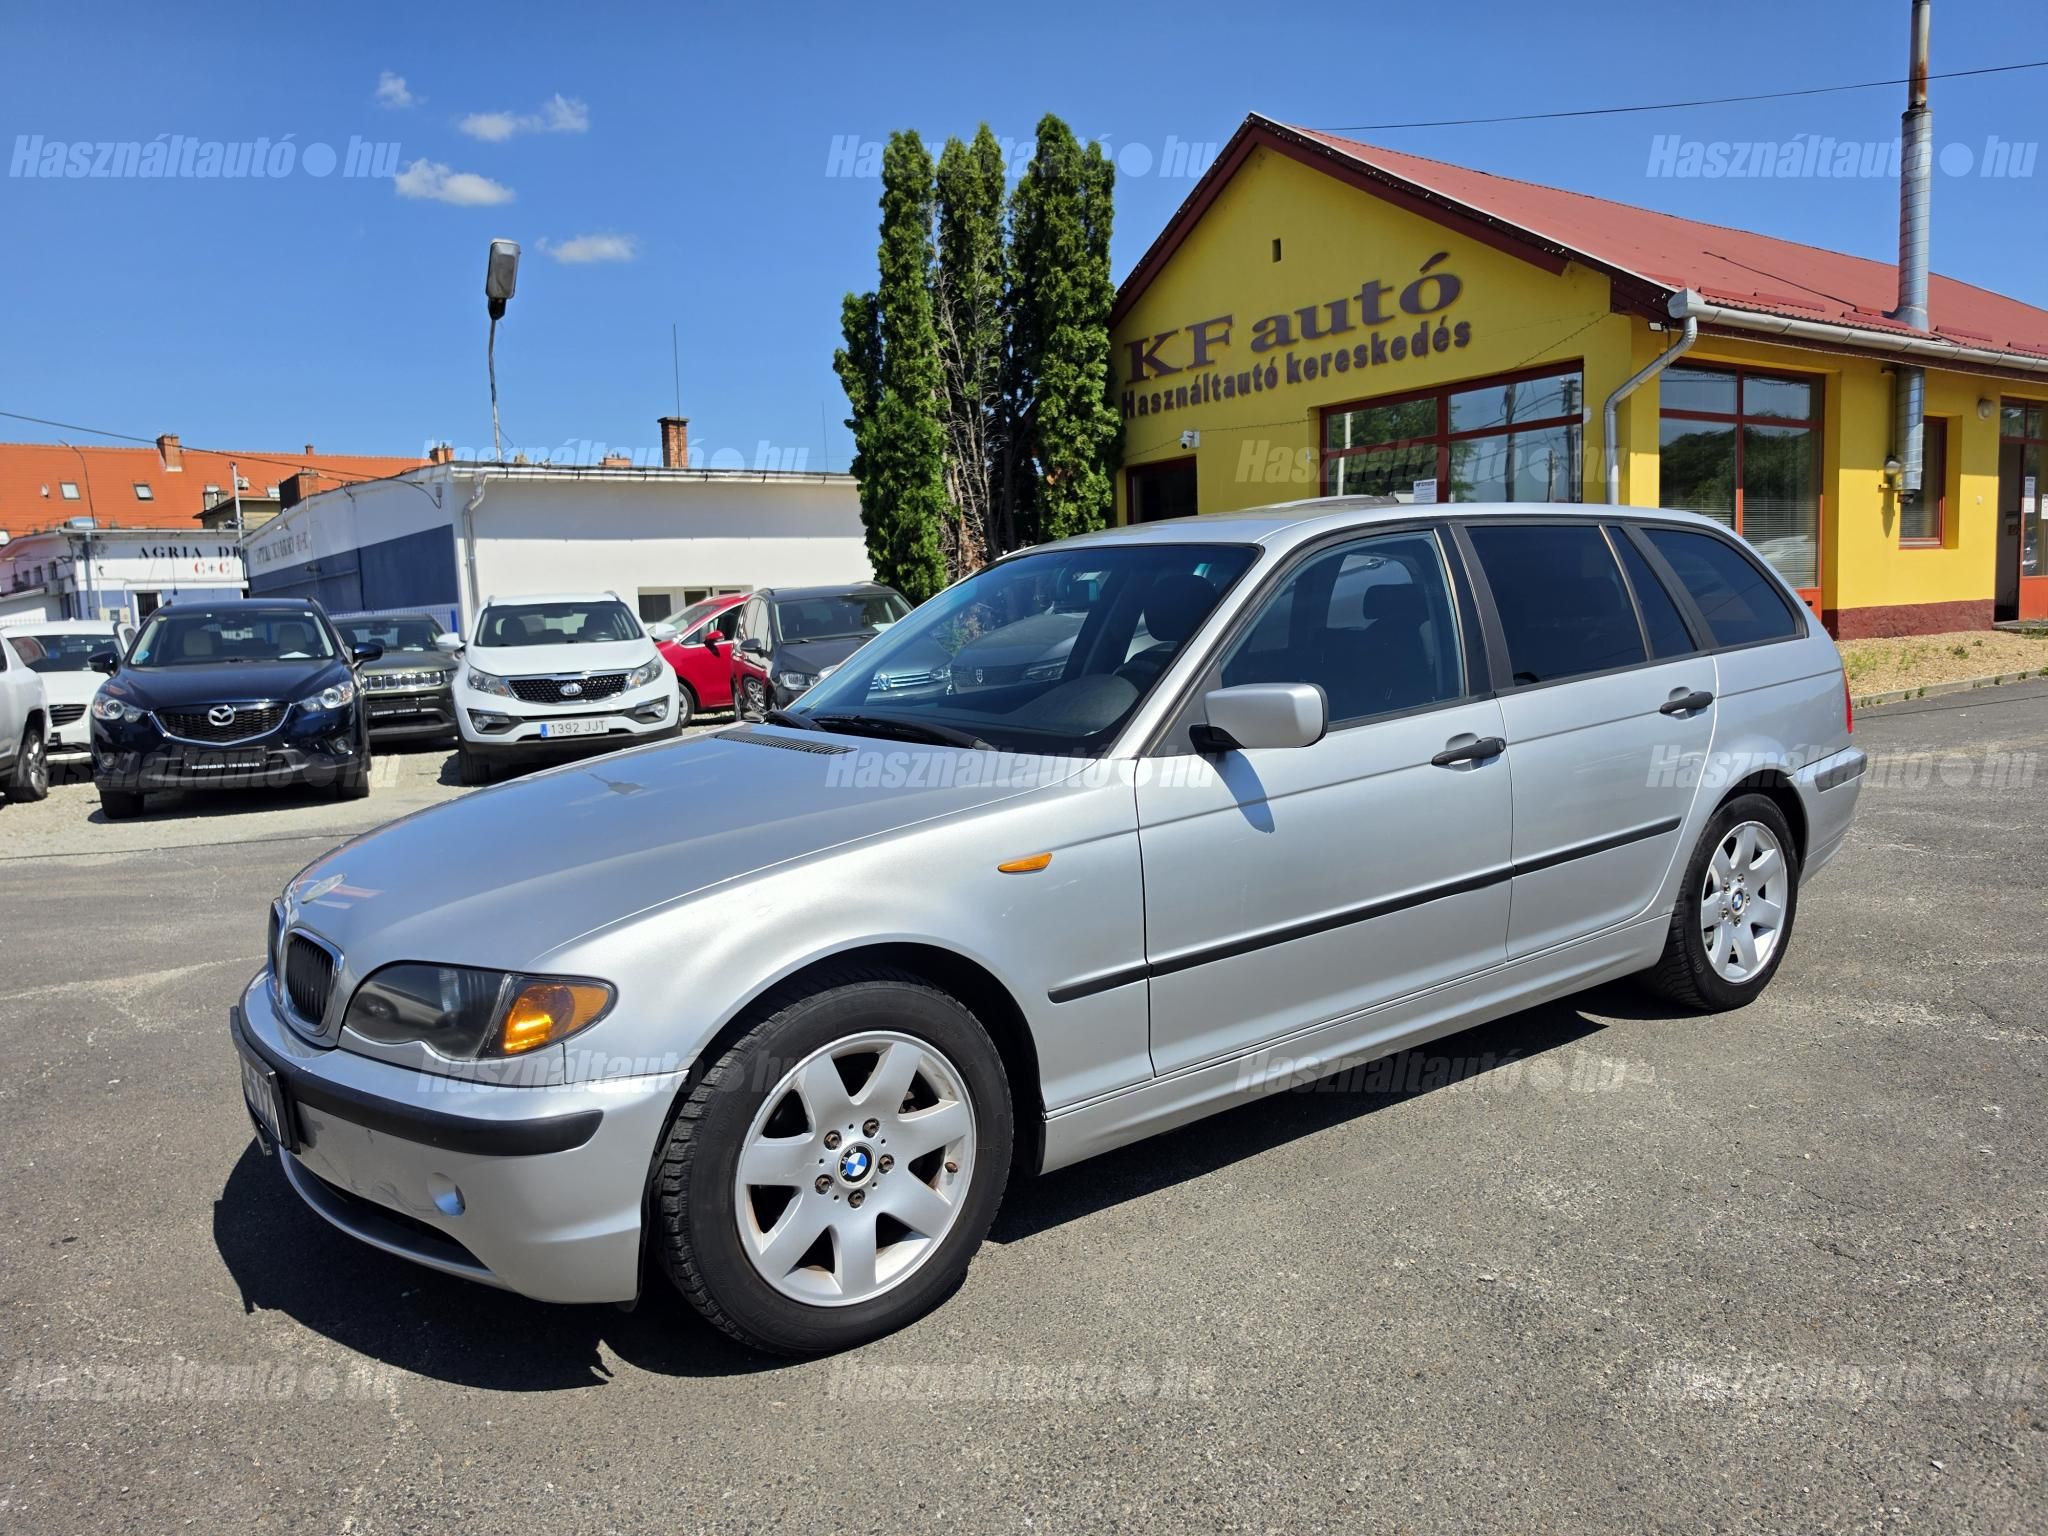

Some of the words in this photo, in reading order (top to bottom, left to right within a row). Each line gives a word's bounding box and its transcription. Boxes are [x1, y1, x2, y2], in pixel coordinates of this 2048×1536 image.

[1124, 315, 1233, 384] KF
[1250, 252, 1463, 353] autó
[1121, 357, 1279, 420] Használtautó
[1286, 315, 1472, 385] kereskedés
[139, 546, 203, 559] AGRIA
[551, 722, 580, 735] 1392
[584, 720, 605, 732] JJT
